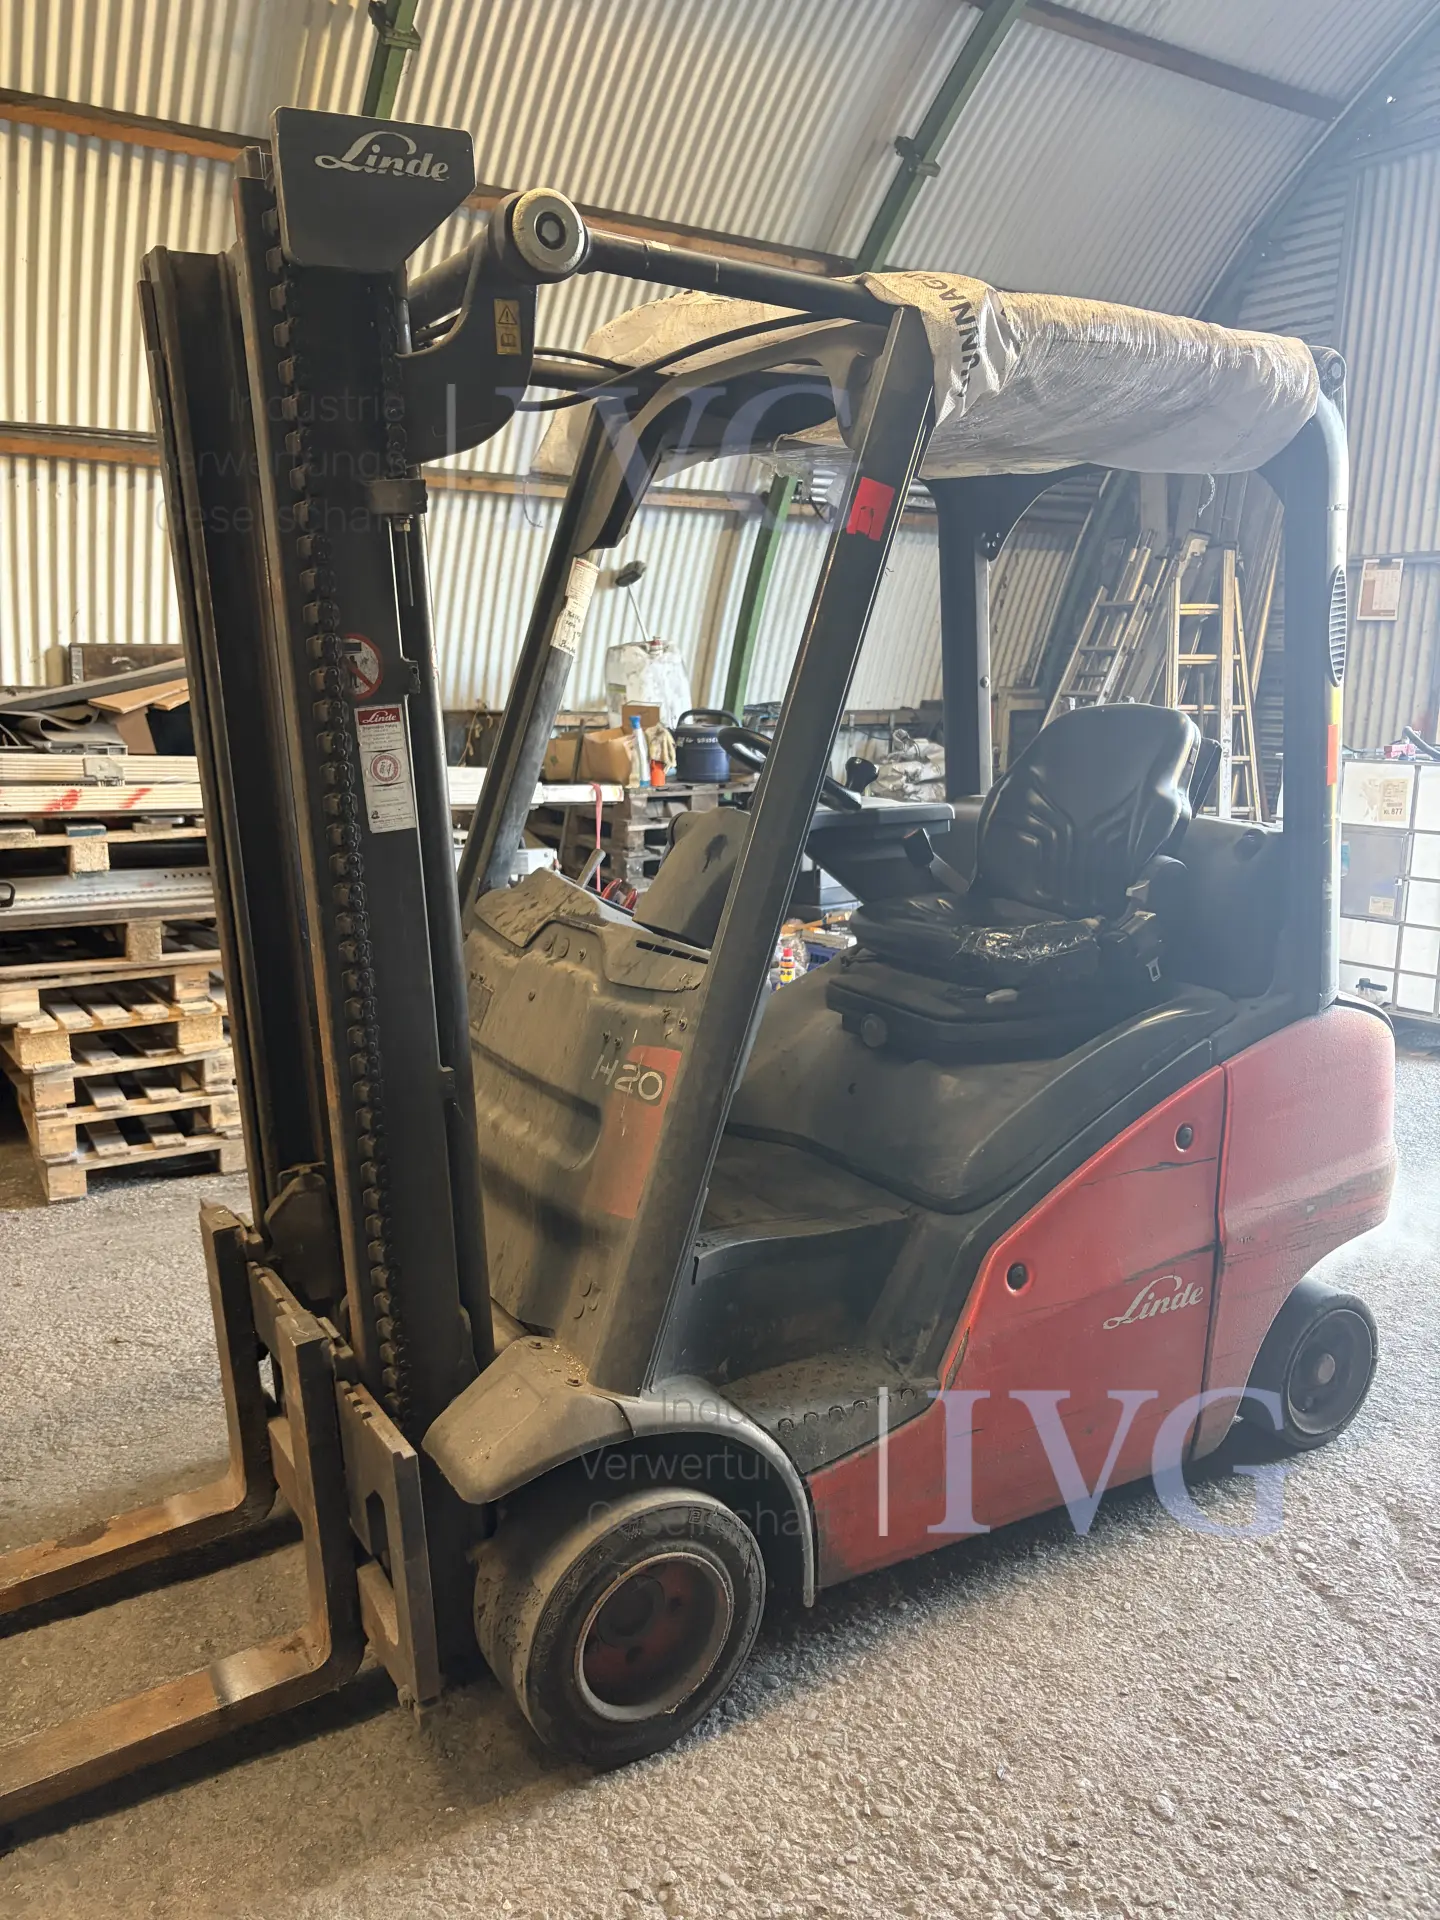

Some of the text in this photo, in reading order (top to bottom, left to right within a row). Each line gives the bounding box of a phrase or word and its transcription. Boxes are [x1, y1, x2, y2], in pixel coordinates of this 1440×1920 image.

[314, 130, 449, 182] Linde
[361, 710, 397, 724] Linde
[1391, 807, 1403, 816] 877
[1102, 1274, 1204, 1330] Linde
